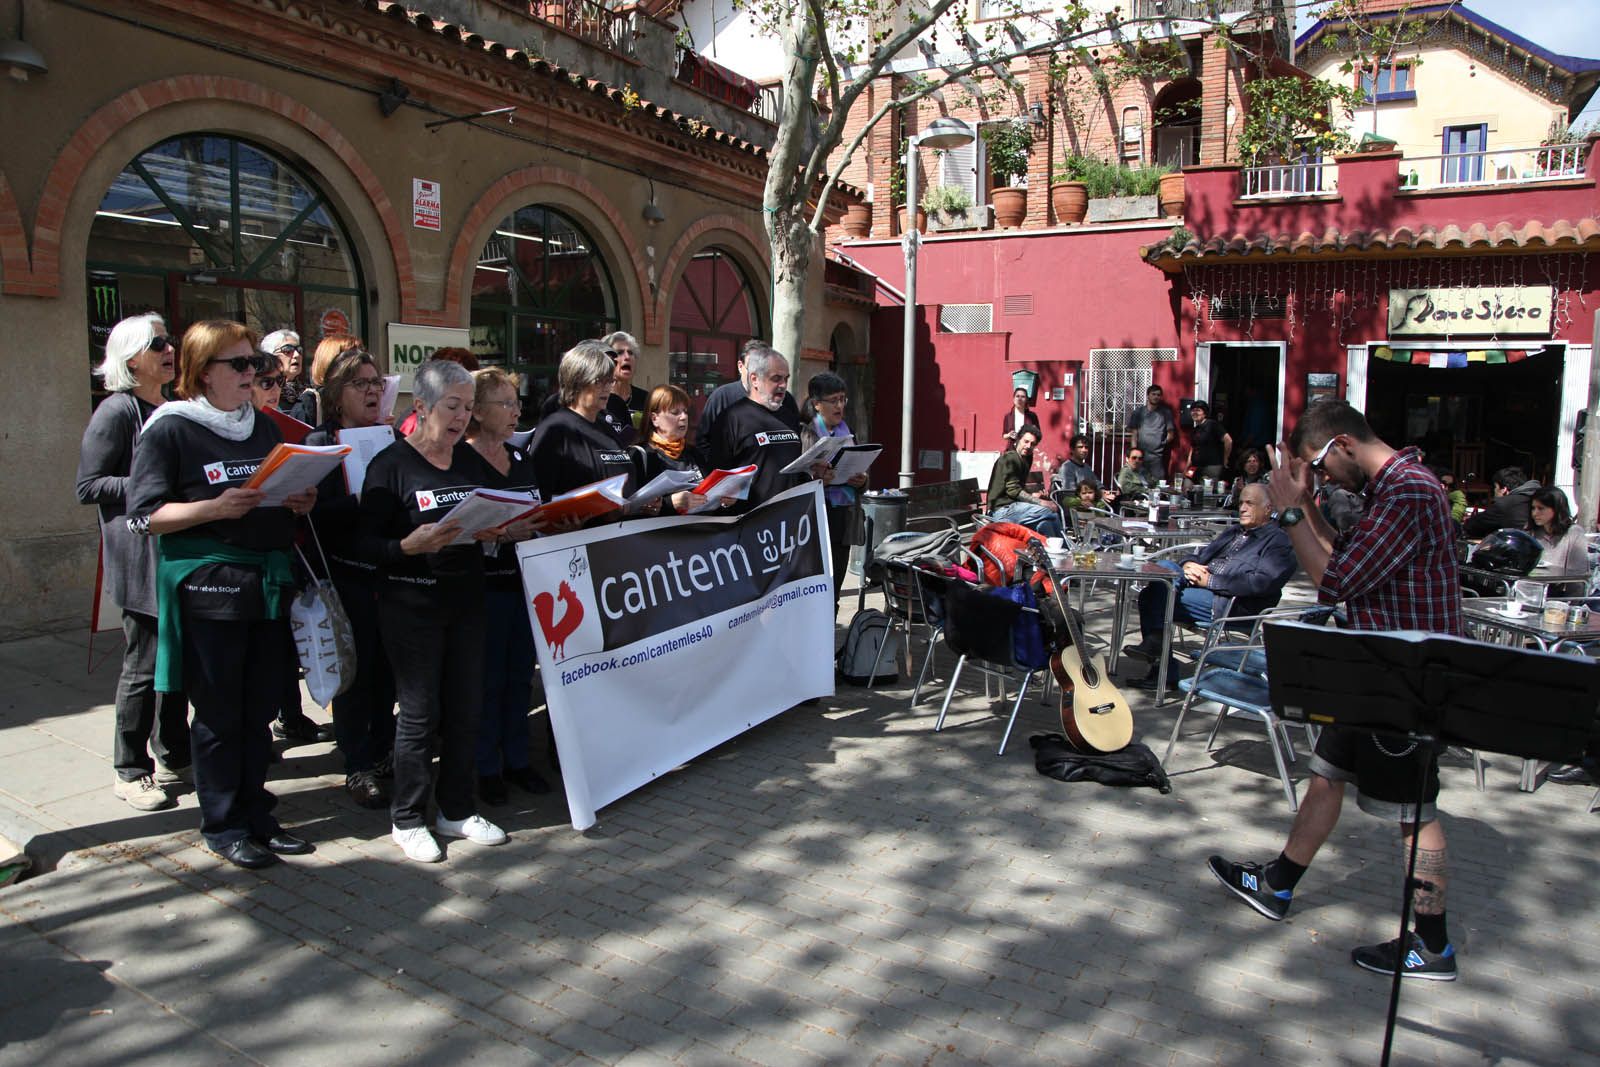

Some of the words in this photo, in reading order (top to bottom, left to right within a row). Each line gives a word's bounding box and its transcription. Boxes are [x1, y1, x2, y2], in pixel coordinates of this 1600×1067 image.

[415, 199, 440, 209] ALARMA
[600, 542, 753, 620] cantem
[756, 528, 780, 574] les
[780, 513, 811, 563] 40
[561, 624, 713, 686] facebook.com/cantemles40
[1242, 871, 1258, 891] N
